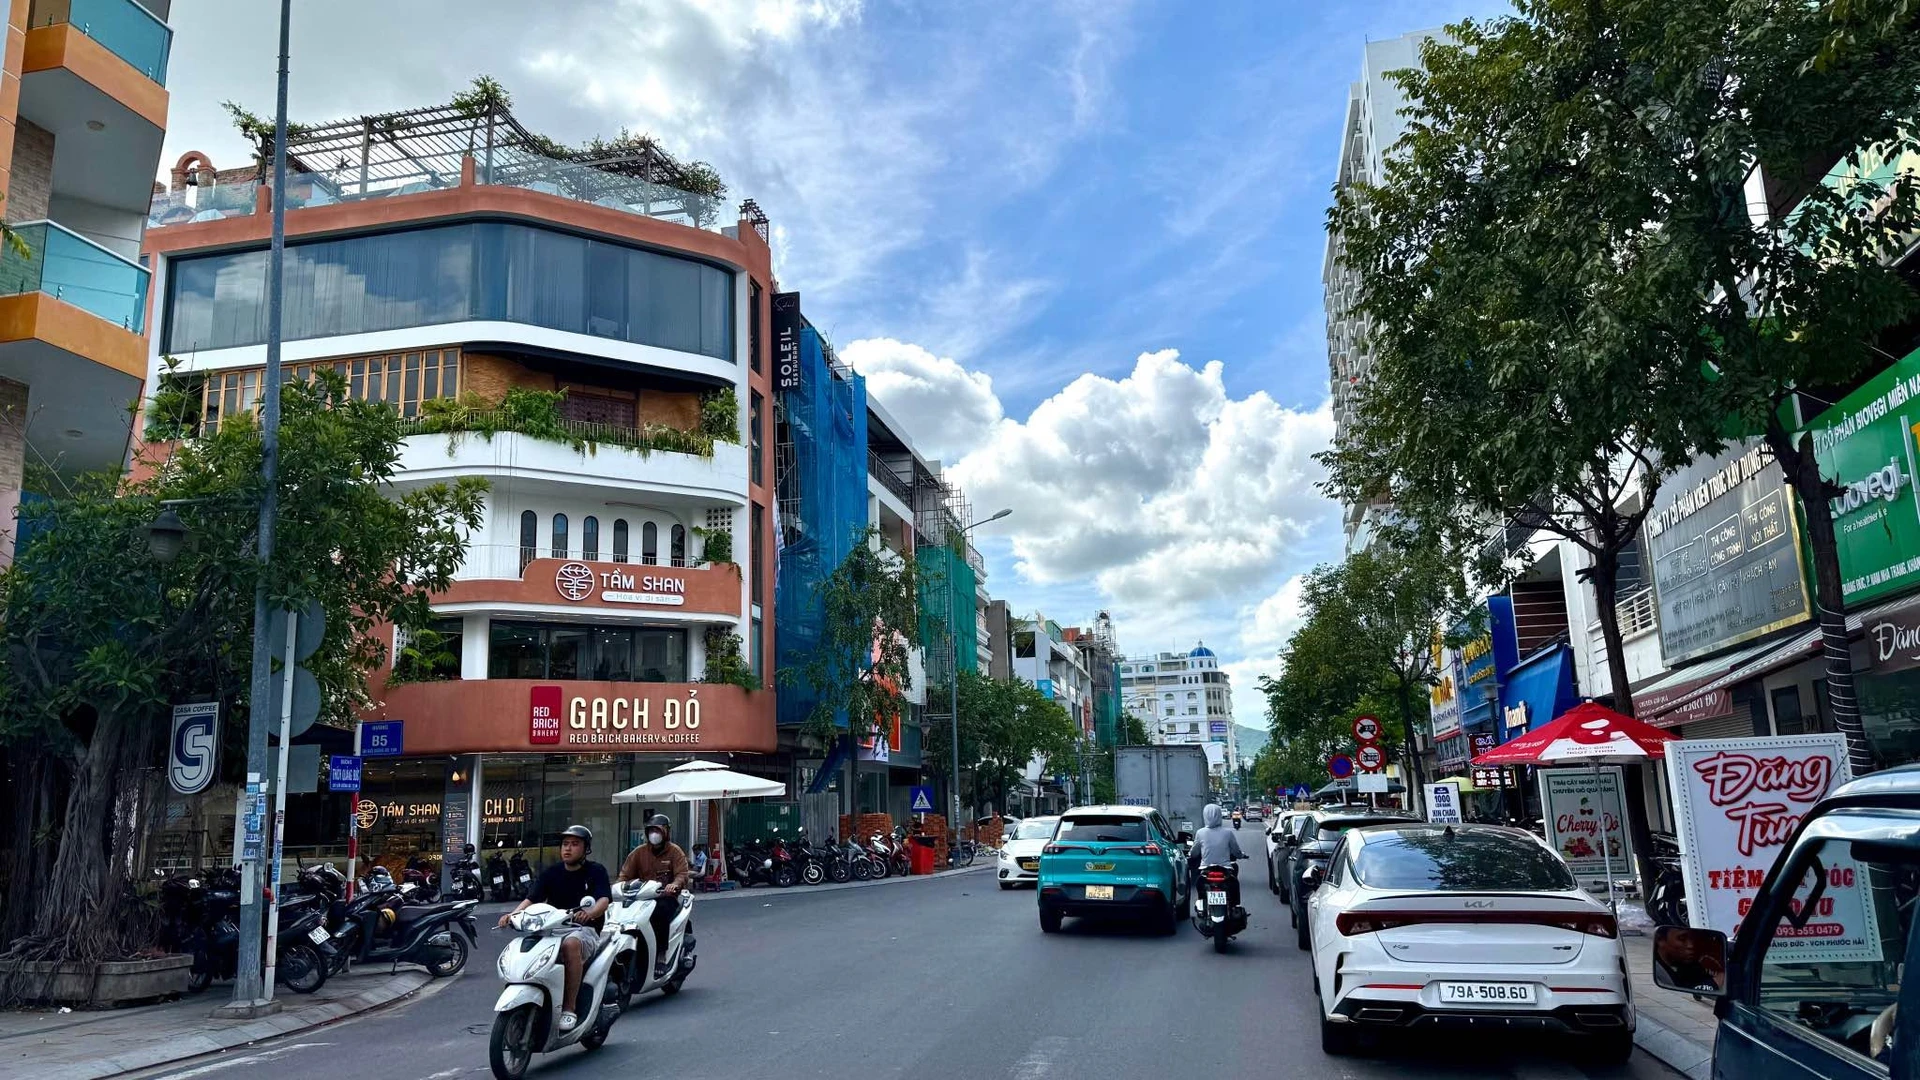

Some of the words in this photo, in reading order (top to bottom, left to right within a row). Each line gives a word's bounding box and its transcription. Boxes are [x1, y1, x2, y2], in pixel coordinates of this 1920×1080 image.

[780, 327, 792, 386] SOLEIL
[1822, 419, 1833, 450] CỔ
[1833, 411, 1855, 442] PHẦN
[1855, 395, 1888, 430] BIOVEGI
[1887, 377, 1908, 411] MIỀN
[1908, 373, 1920, 400] NA
[1661, 508, 1671, 531] TY
[1694, 477, 1710, 511] KIẾN
[1708, 469, 1728, 500] TRÚC
[1725, 459, 1742, 491] XÂY
[1740, 446, 1762, 481] DỰNG
[1760, 502, 1777, 520] CÔNG
[1720, 525, 1736, 542] CÔNG
[1843, 521, 1853, 534] For
[1710, 549, 1725, 566] CÔNG
[600, 568, 635, 590] TẦM
[642, 576, 685, 593] SHAN
[1871, 621, 1920, 661] Đăn
[192, 704, 217, 713] COFFEE
[533, 706, 550, 717] RED
[570, 697, 649, 733] GẠCH
[664, 689, 700, 729] ĐỎ
[532, 718, 559, 729] BRICK
[372, 734, 388, 747] B5
[569, 733, 588, 743] RED
[591, 733, 621, 743] BRICK
[623, 733, 660, 743] BAKERY
[668, 733, 700, 743] COFFEE
[1694, 752, 1831, 807] Đăng
[1434, 794, 1451, 803] 1000
[380, 801, 404, 817] TẦM
[409, 803, 441, 816] SHAN
[1432, 809, 1441, 817] XIN
[1557, 814, 1598, 837] Cherry
[1708, 865, 1764, 894] TIỆM
[1825, 863, 1855, 889] ÓC
[1776, 927, 1795, 936] 093
[1816, 925, 1841, 935] 0479
[1448, 984, 1528, 1000] 79A-508.60
